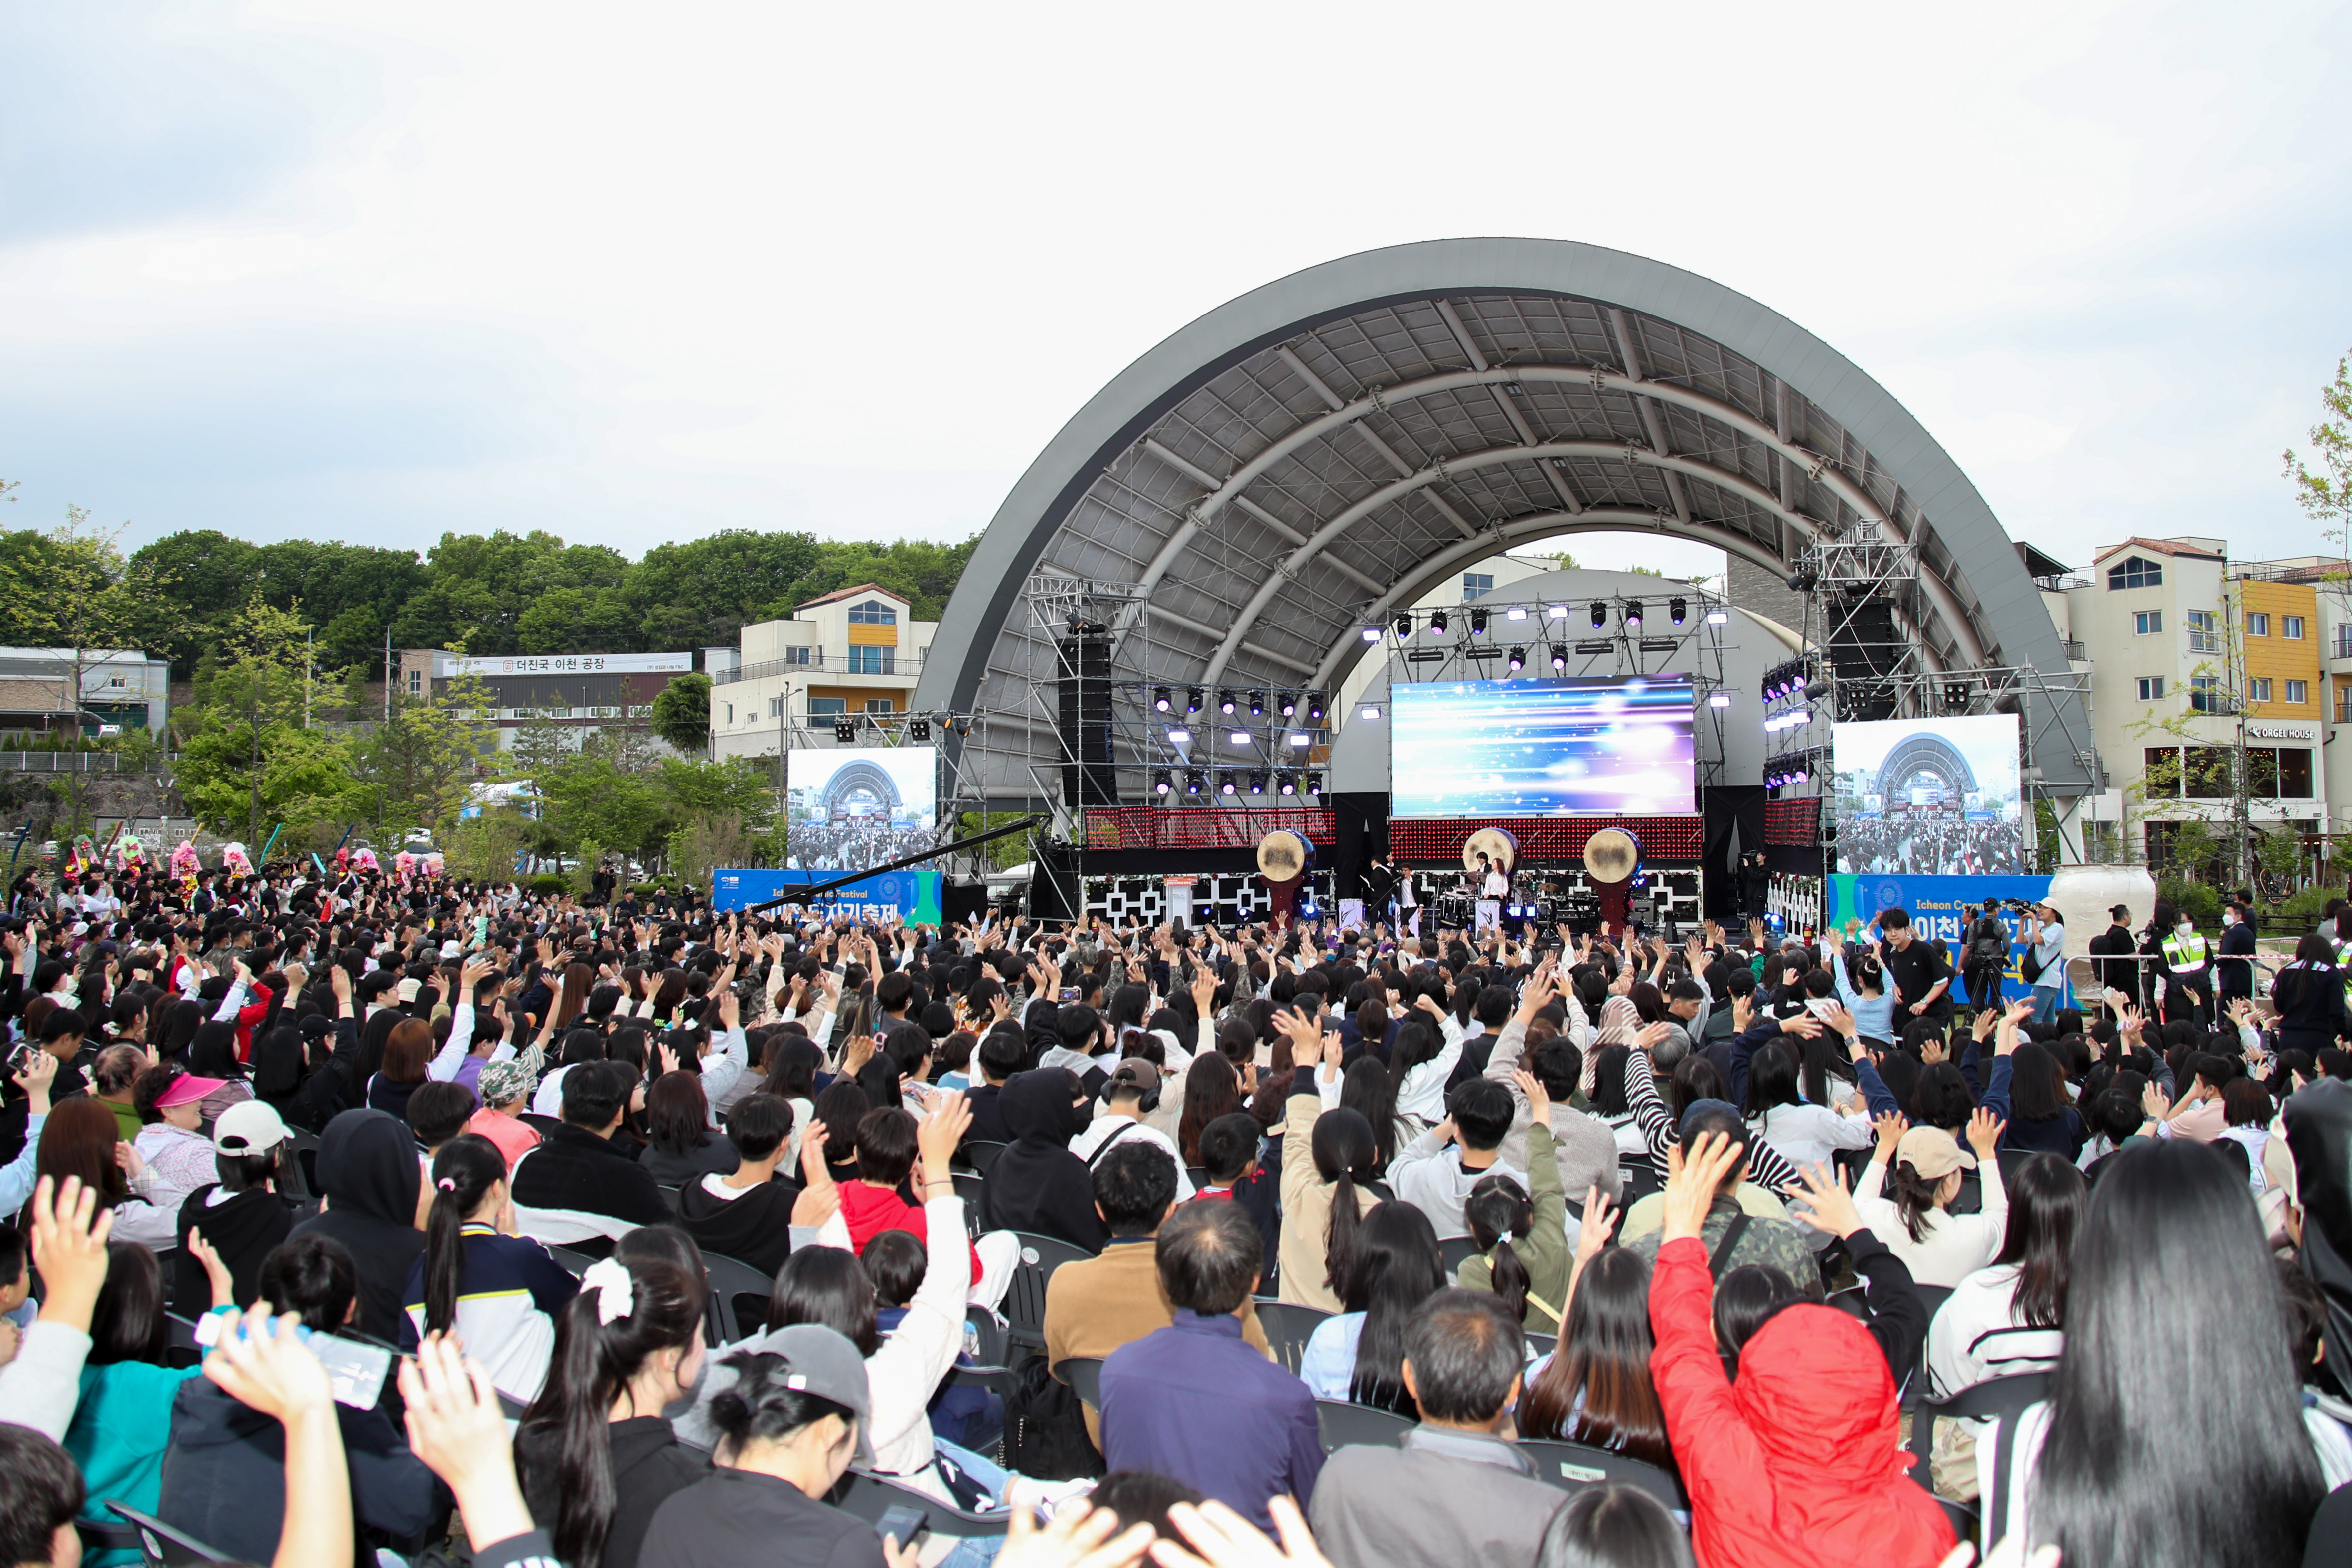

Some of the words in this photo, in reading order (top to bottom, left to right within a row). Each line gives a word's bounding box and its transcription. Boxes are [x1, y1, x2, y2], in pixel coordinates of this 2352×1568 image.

[517, 659, 548, 671] 더진국
[556, 658, 576, 670] 이천
[582, 658, 605, 670] 공장
[2262, 728, 2287, 738] ORGEL
[2289, 730, 2314, 738] HOUSE
[837, 889, 868, 899] Festival
[1916, 899, 1951, 910] Icheon
[1022, 1252, 1038, 1260] 1-10
